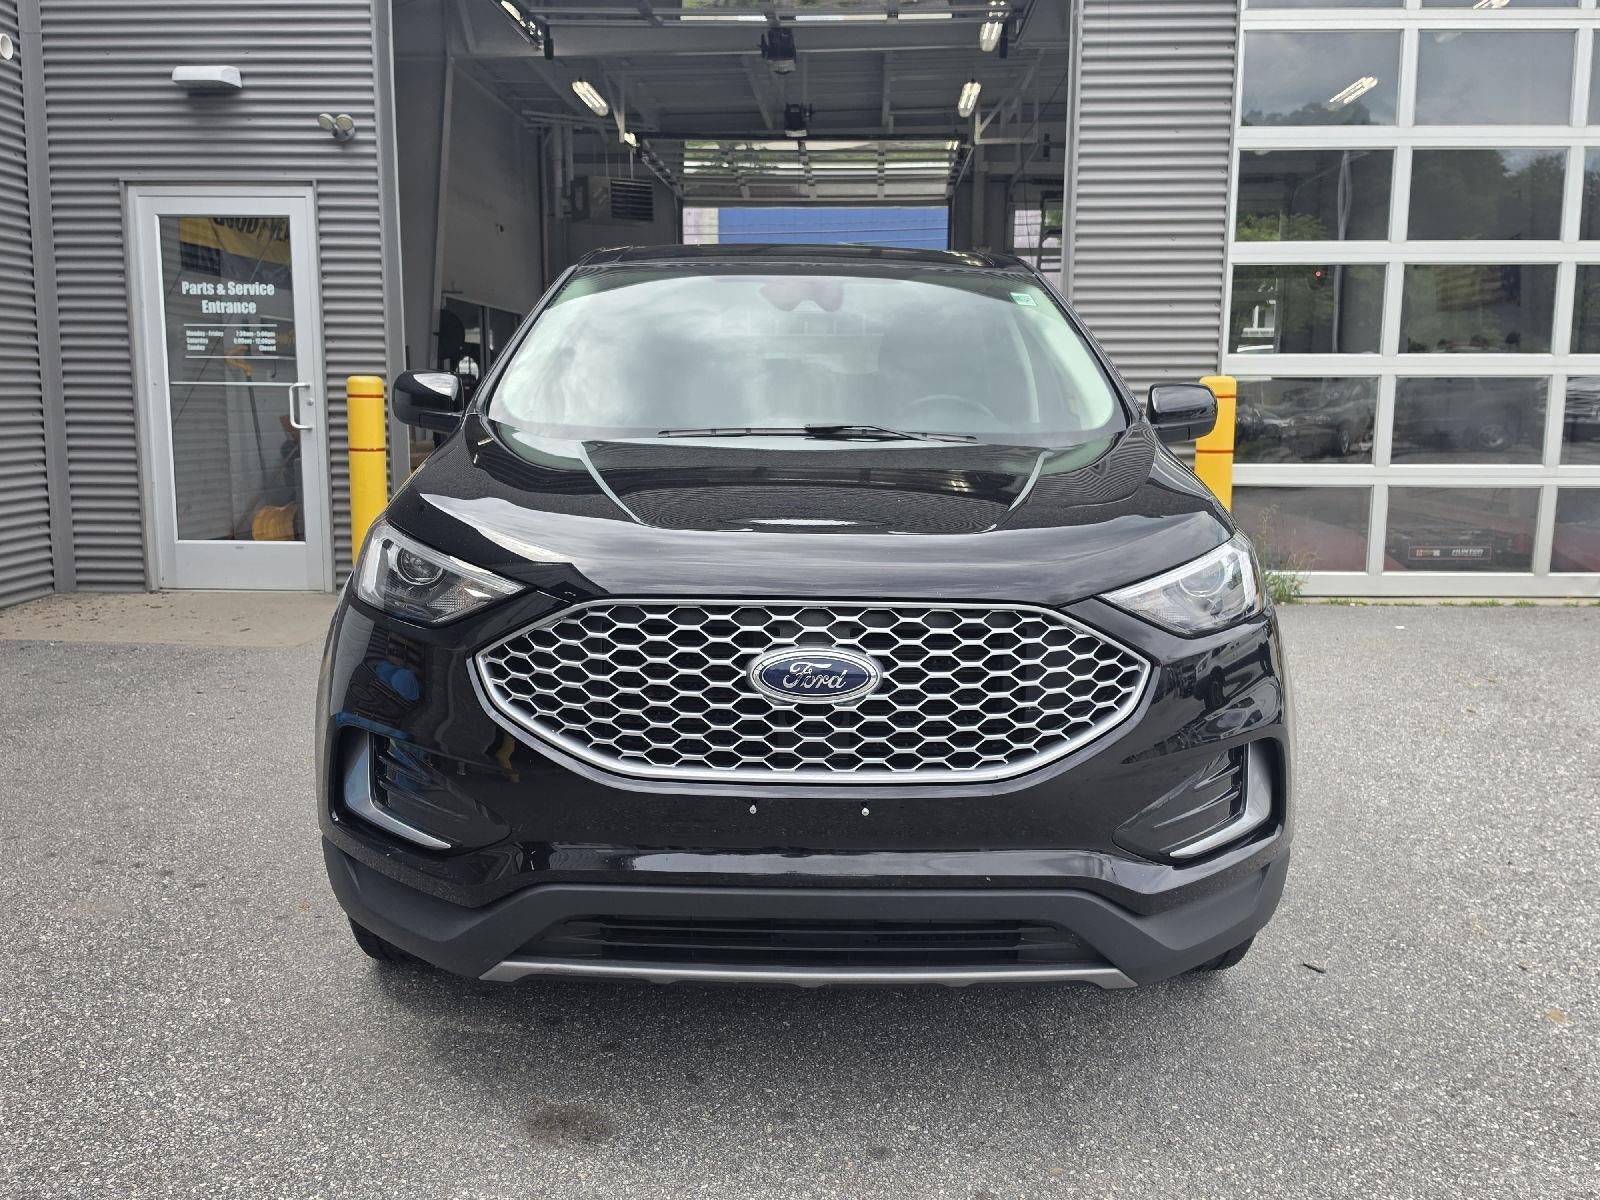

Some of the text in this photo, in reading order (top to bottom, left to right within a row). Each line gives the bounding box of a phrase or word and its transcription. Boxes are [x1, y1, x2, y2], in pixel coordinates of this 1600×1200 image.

[181, 281, 275, 296] Parts & Service
[201, 299, 257, 314] Entrance
[782, 661, 848, 689] Ford
